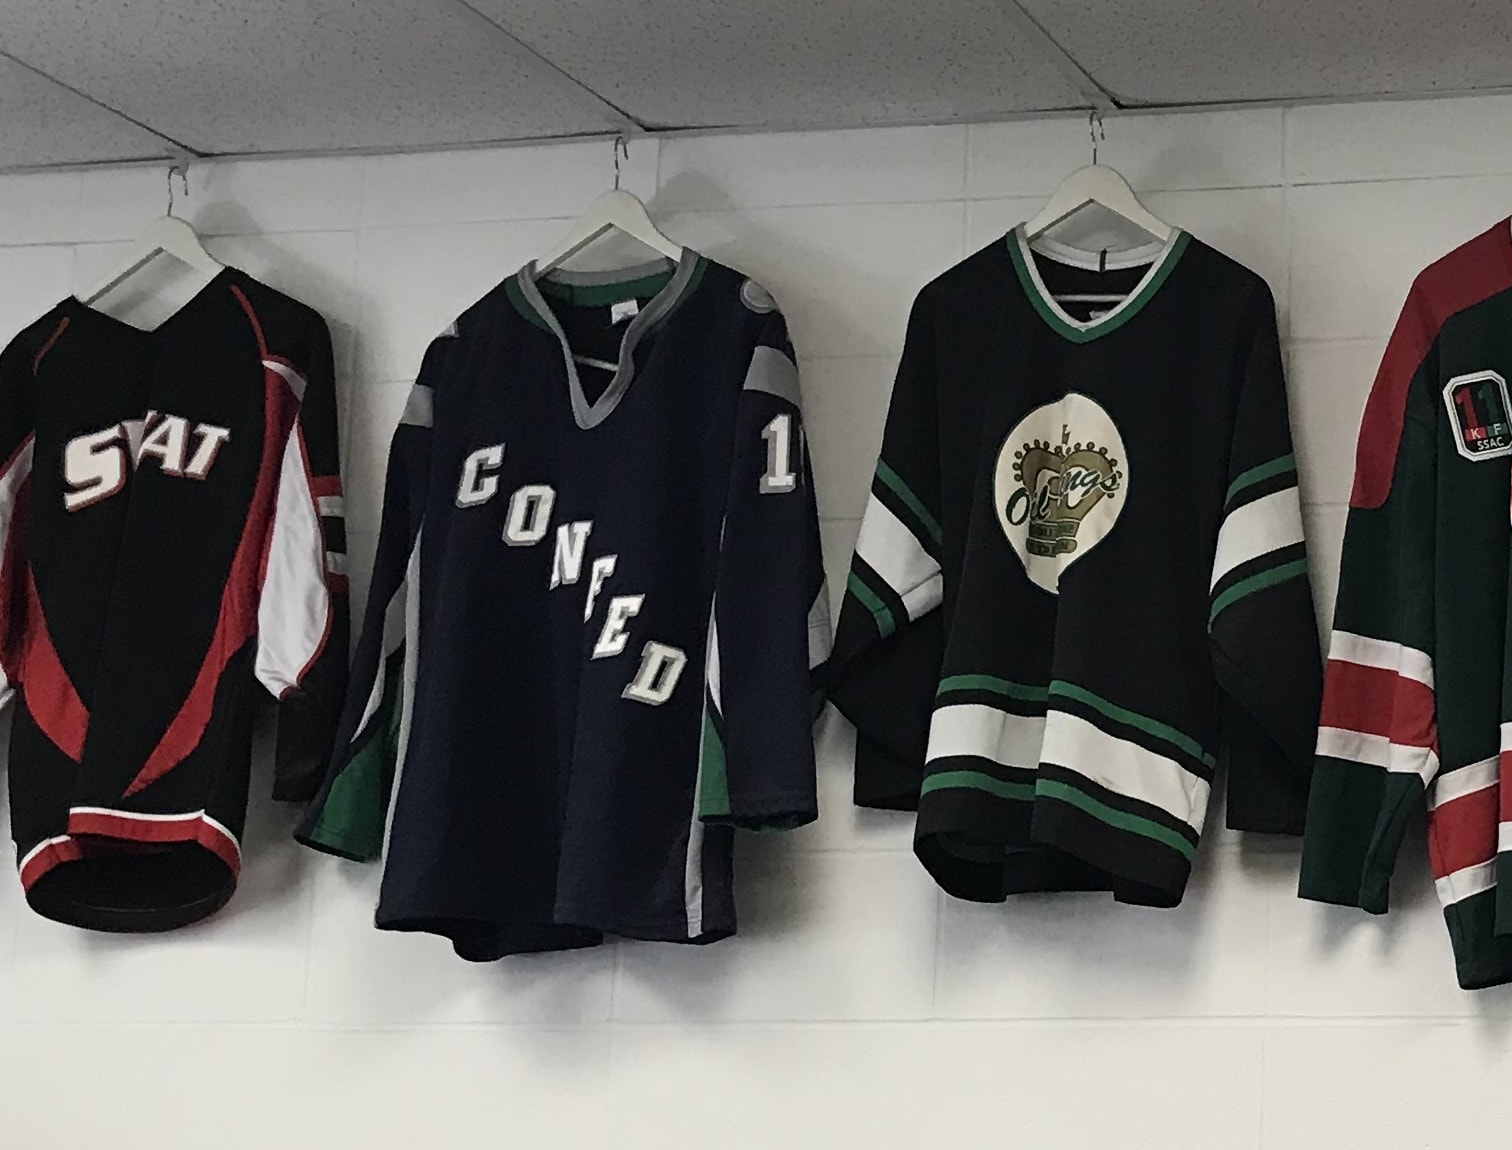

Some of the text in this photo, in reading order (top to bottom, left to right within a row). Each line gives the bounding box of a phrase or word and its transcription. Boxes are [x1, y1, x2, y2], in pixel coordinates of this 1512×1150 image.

[759, 412, 806, 494] 1
[1476, 436, 1505, 451] SSAC
[454, 442, 689, 707] CONFED
